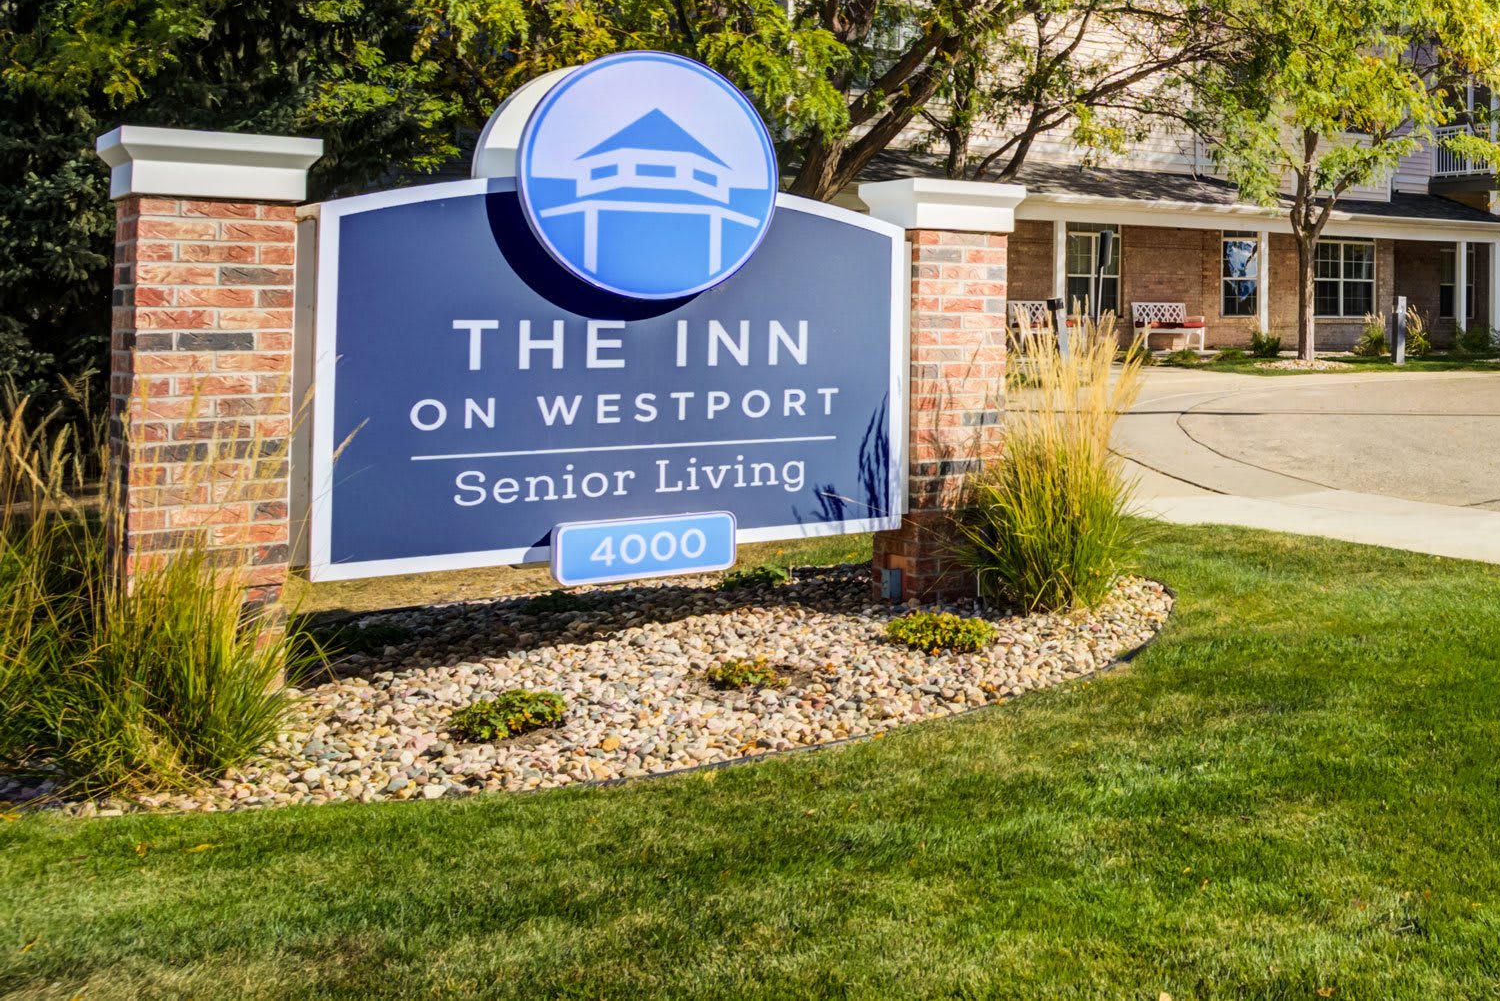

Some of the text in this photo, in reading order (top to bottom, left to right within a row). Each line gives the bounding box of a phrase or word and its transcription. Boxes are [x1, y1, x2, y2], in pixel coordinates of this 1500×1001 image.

[453, 319, 809, 371] THE INN
[410, 387, 839, 431] ON WESTPORT
[453, 454, 806, 507] Senior Living
[589, 527, 707, 568] 4000
